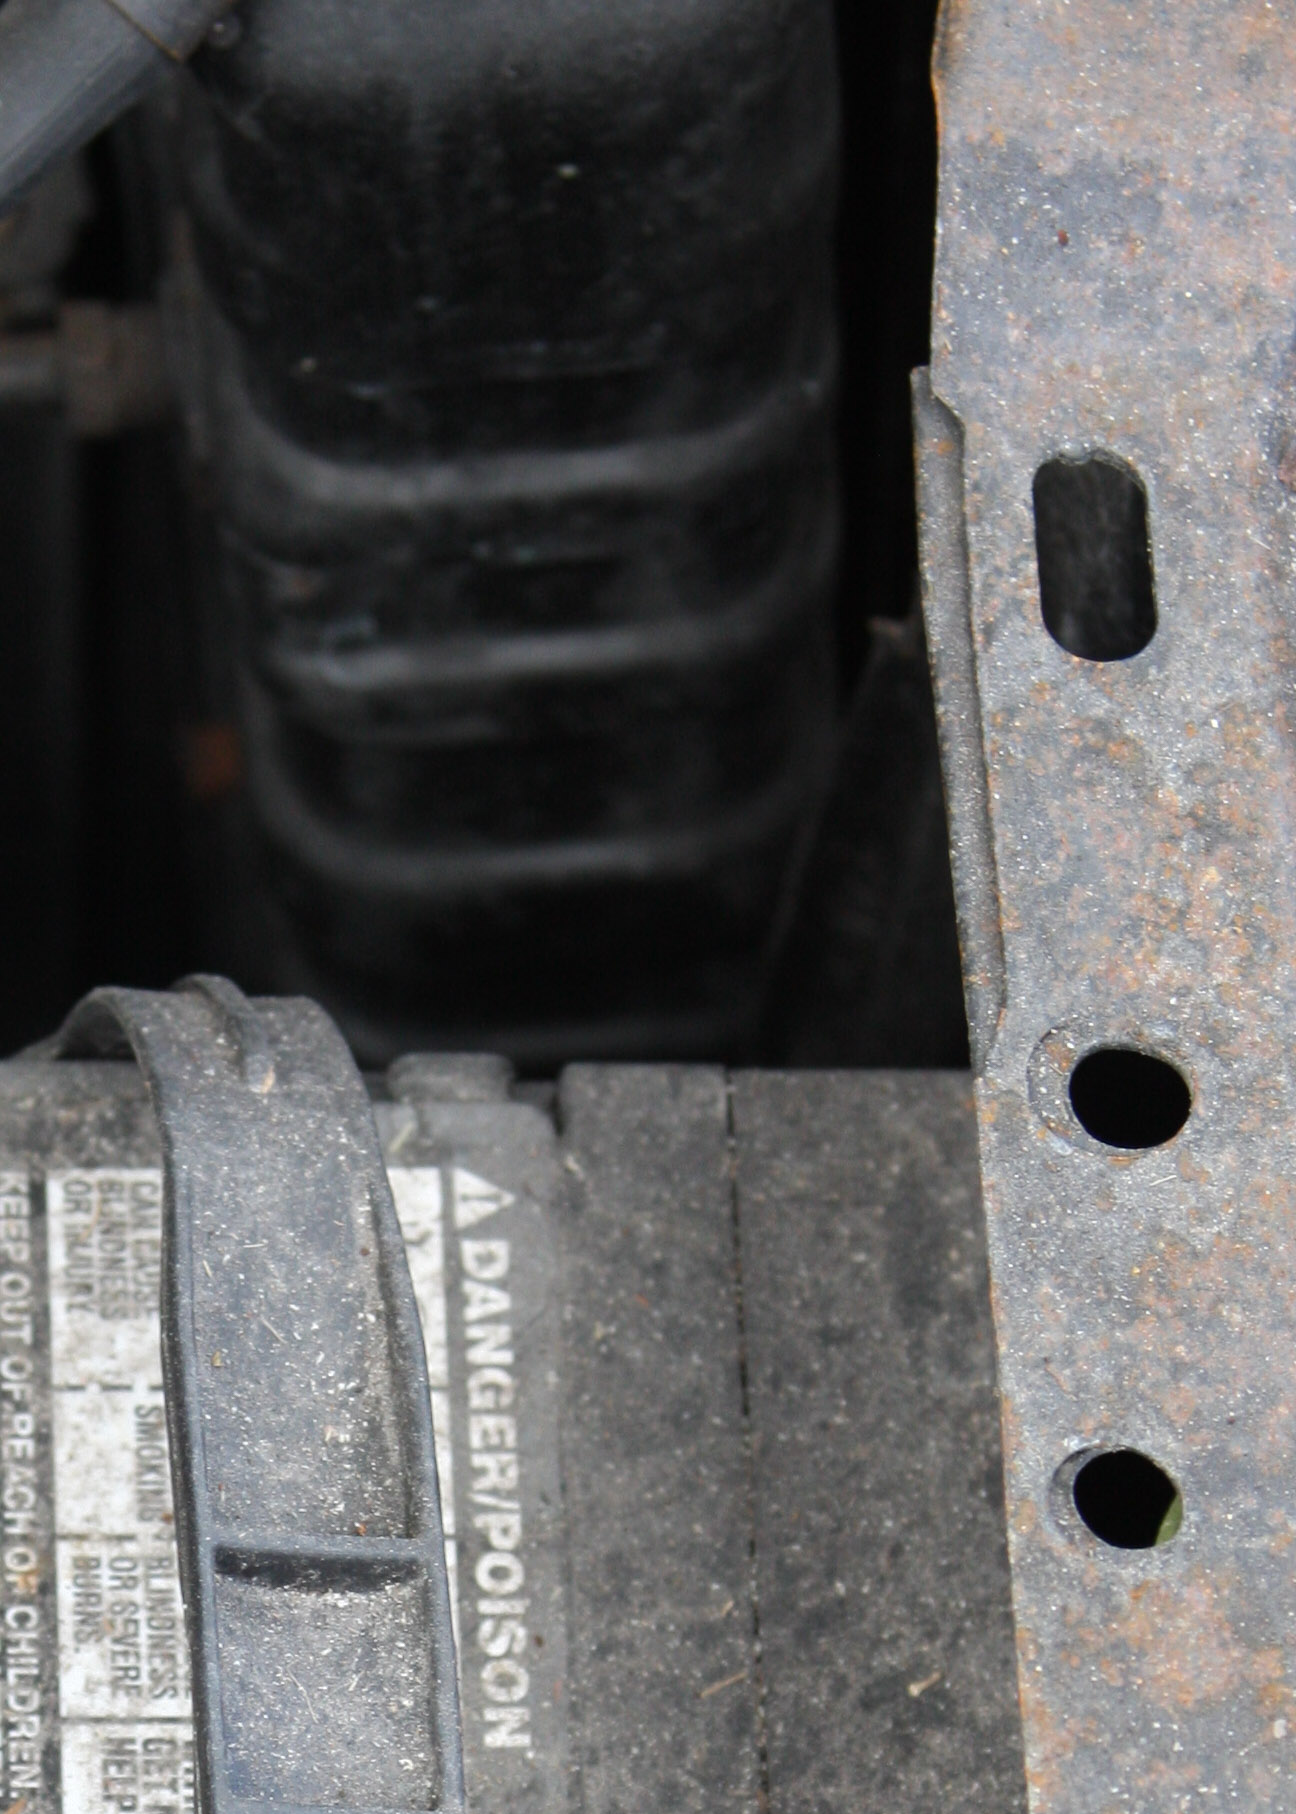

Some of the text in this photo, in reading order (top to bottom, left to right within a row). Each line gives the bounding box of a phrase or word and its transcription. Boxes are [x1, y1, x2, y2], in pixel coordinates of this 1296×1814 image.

[0, 1356, 34, 1400] OF
[2, 1413, 37, 1535] REACH
[134, 1405, 170, 1522] SMOKING
[461, 1239, 531, 1750] DANGER/POISON
[4, 1547, 39, 1595] OF
[108, 1557, 143, 1699] OR SEVERE
[146, 1557, 179, 1700] BLINDNESS
[5, 1604, 42, 1799] CHILDREN.
[103, 1737, 140, 1813] HELP
[143, 1737, 181, 1793] GET
